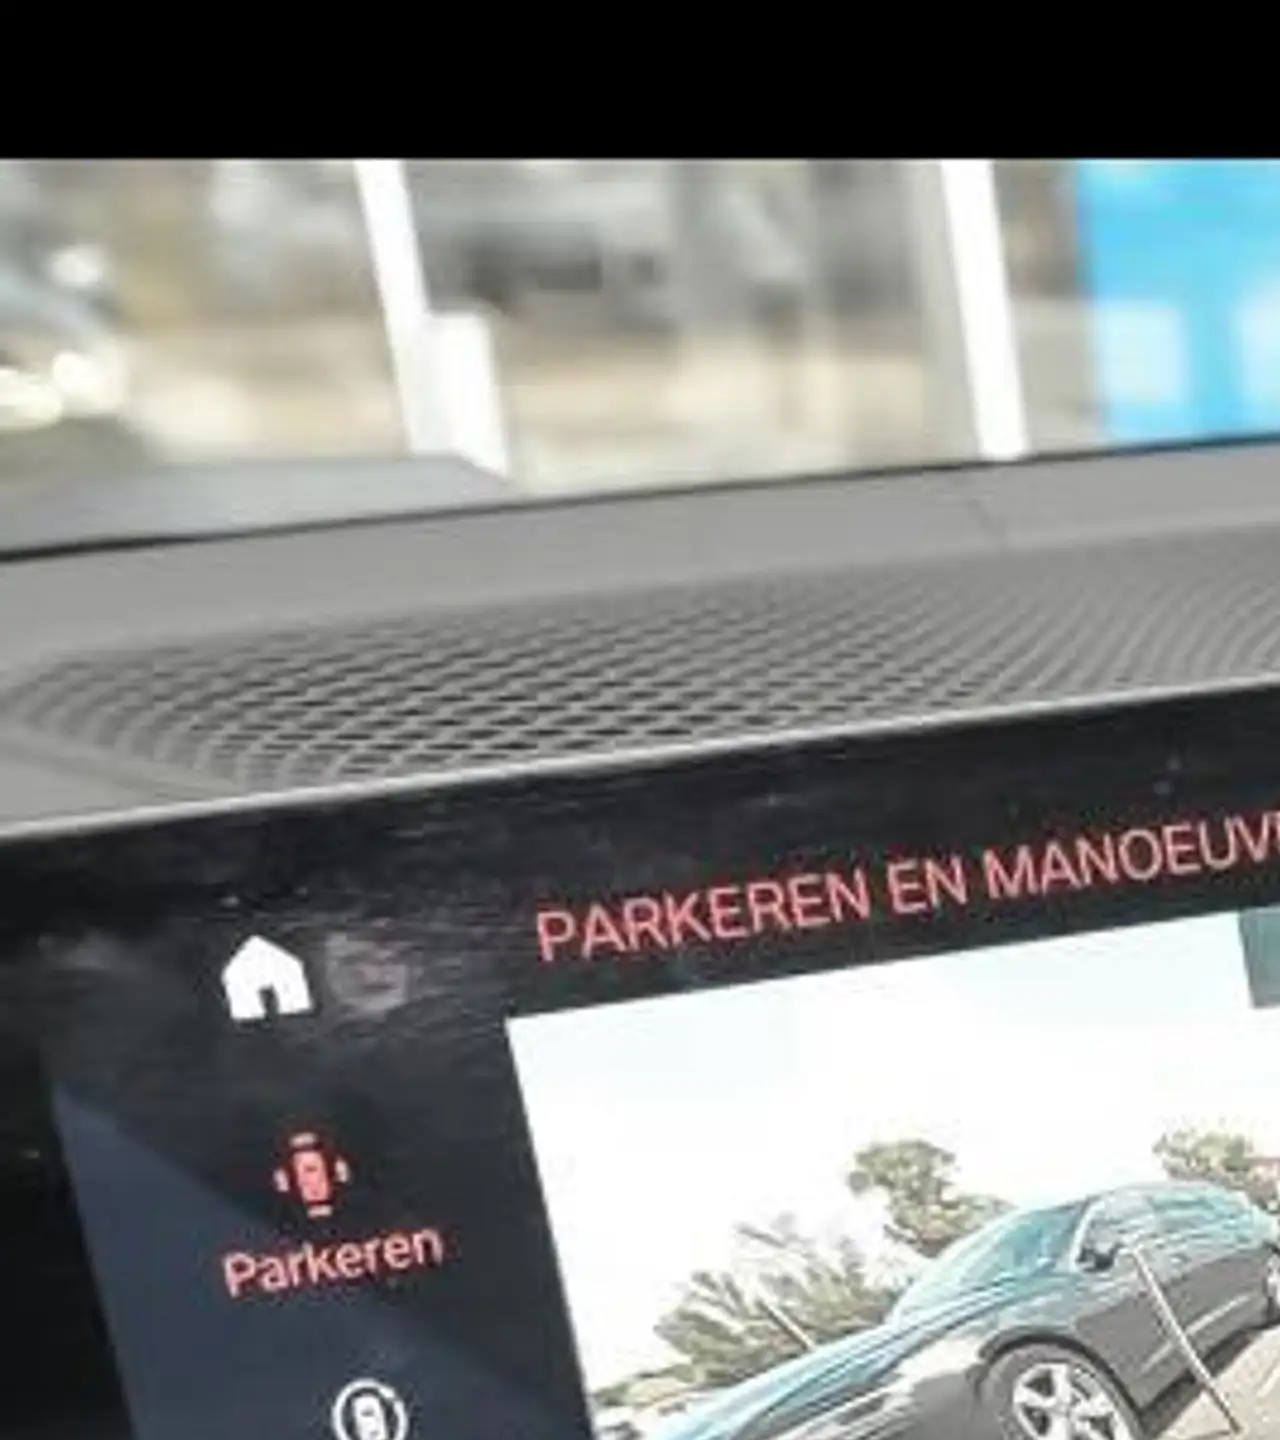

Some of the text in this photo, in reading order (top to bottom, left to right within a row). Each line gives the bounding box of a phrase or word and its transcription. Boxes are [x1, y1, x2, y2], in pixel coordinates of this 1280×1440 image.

[535, 866, 872, 963] PARKEREN
[887, 855, 970, 917] EN
[223, 1226, 444, 1298] Parkeren
